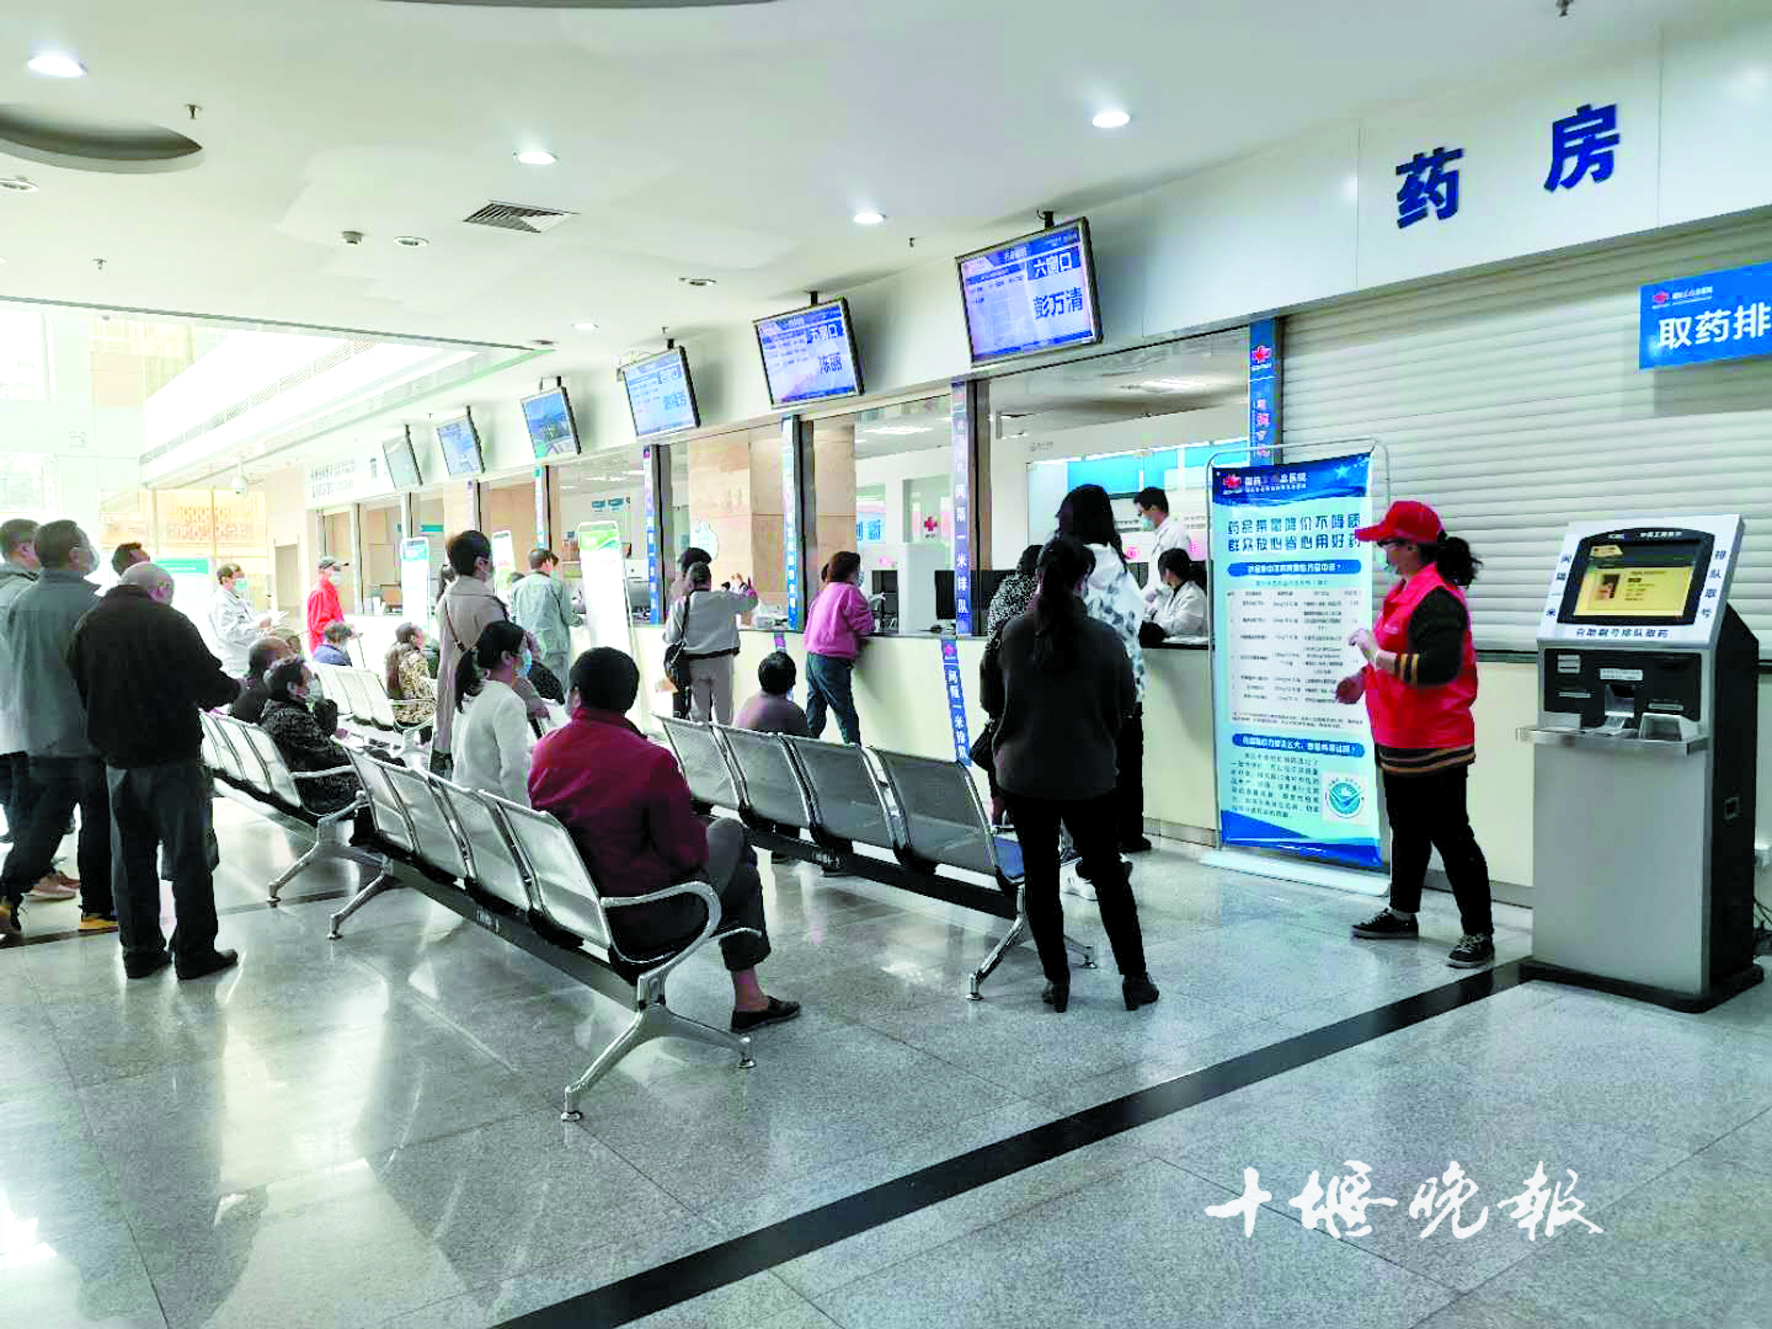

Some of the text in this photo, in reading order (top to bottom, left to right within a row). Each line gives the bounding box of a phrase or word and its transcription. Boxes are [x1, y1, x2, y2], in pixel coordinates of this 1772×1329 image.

[1396, 104, 1621, 229] 药房
[1033, 287, 1084, 320] 彭万清
[1658, 301, 1772, 350] 取药排
